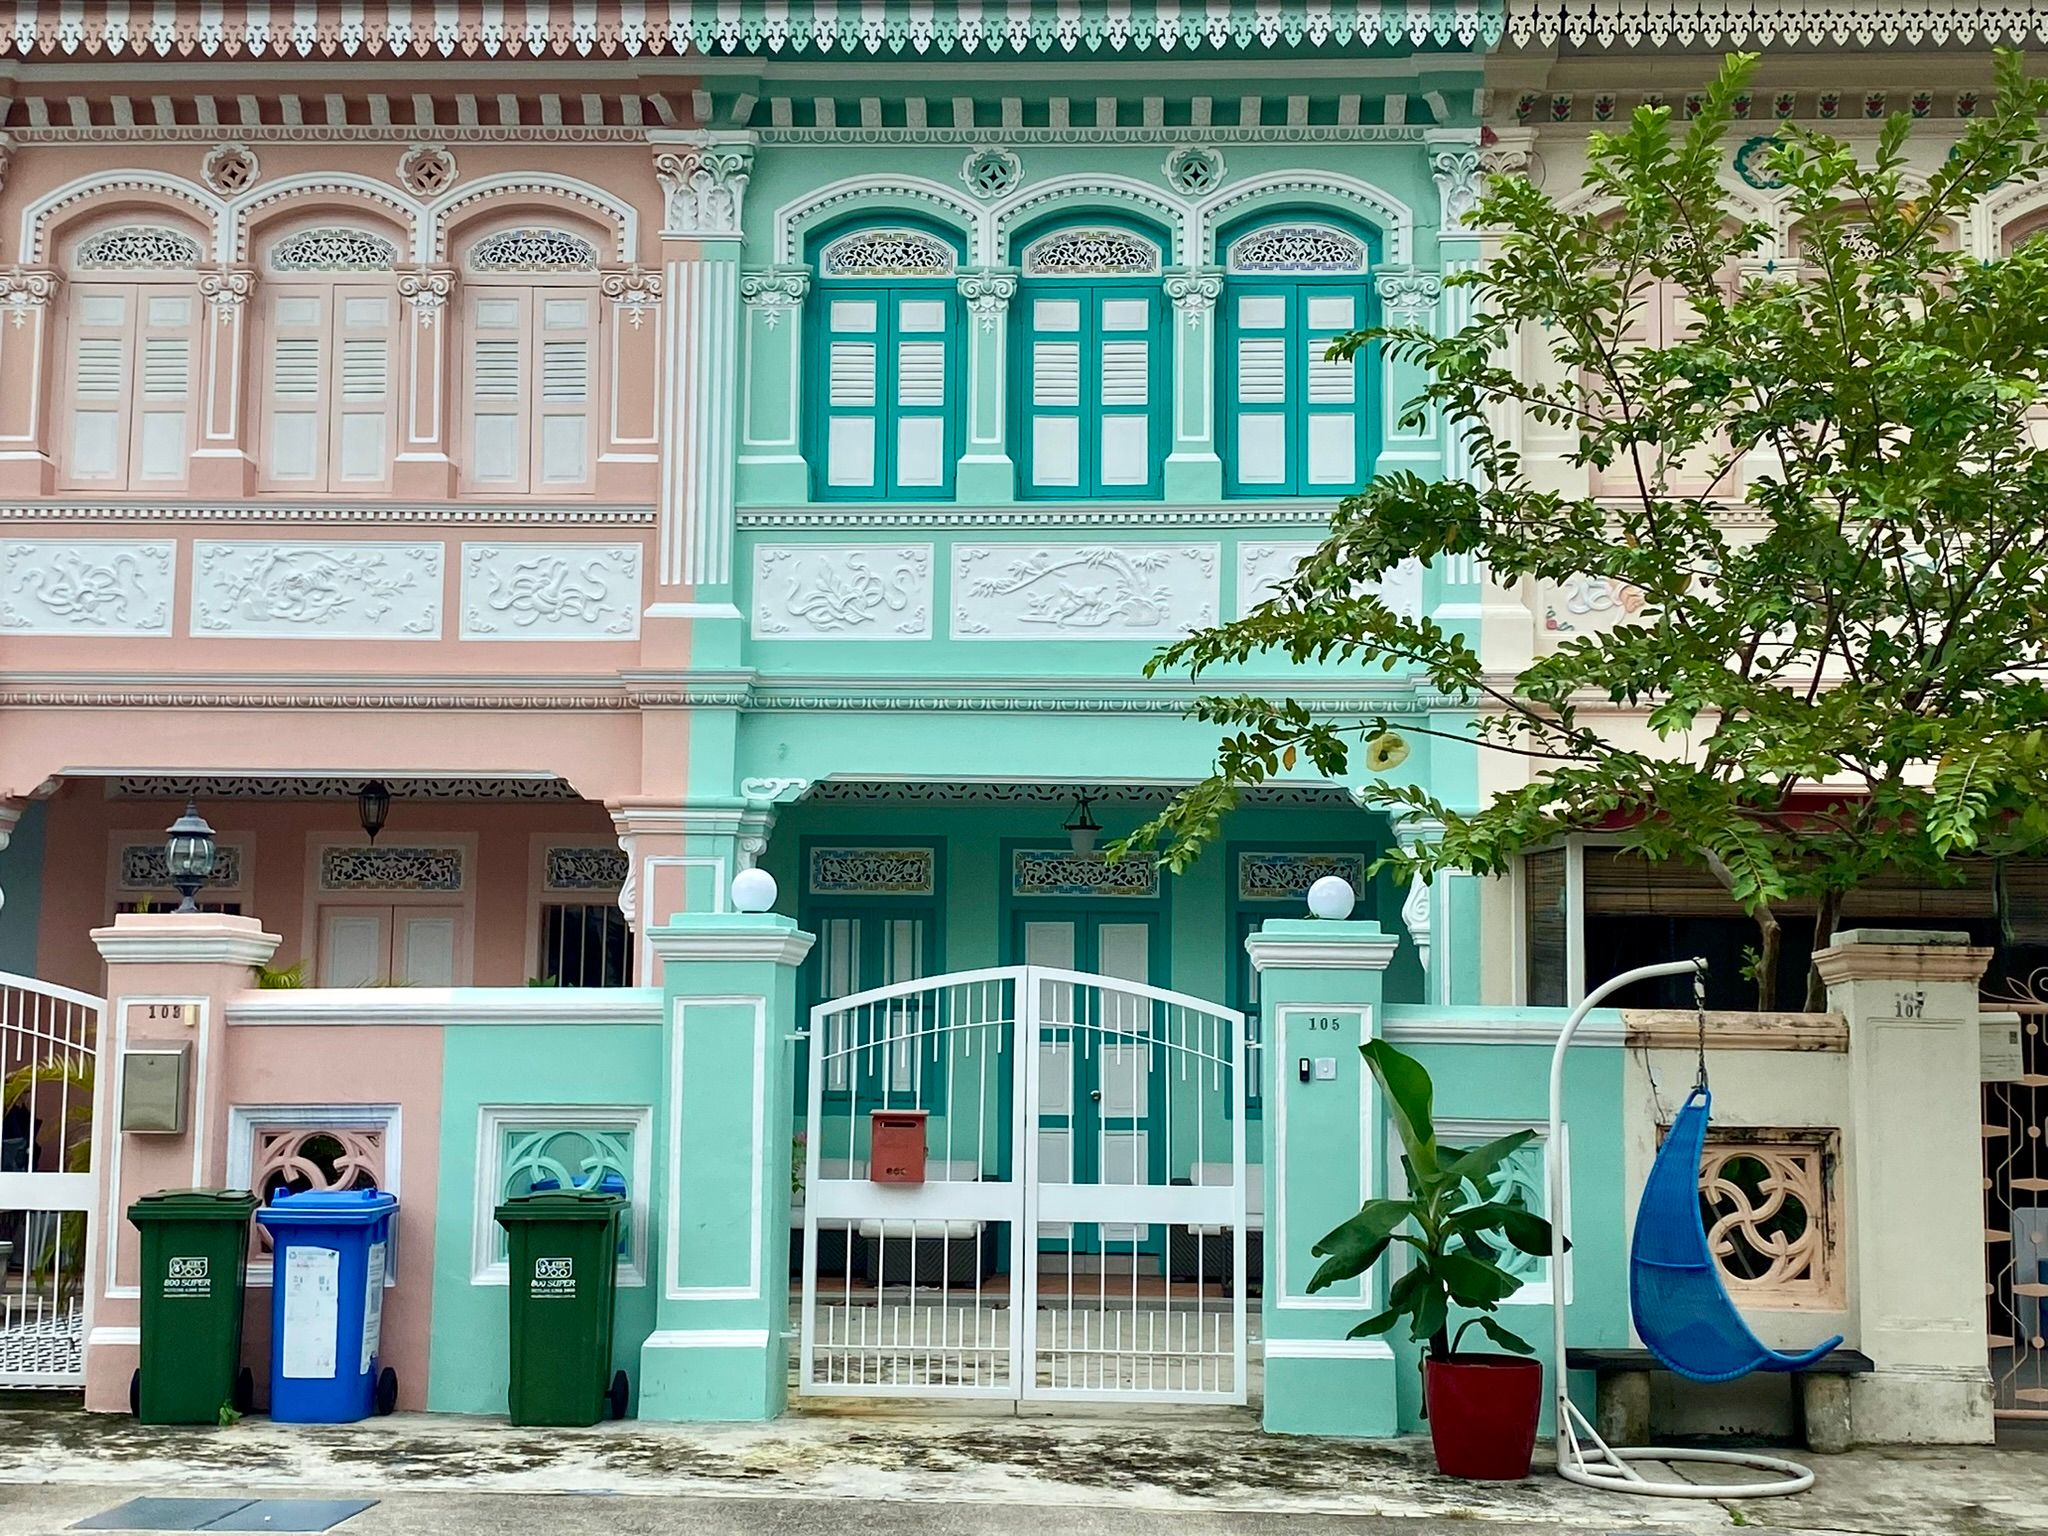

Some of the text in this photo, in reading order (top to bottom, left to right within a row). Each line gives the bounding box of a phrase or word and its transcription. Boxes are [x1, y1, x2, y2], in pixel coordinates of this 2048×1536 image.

[1895, 1000, 1922, 1018] 107
[1308, 1017, 1340, 1031] 105
[181, 1279, 211, 1287] SUPER
